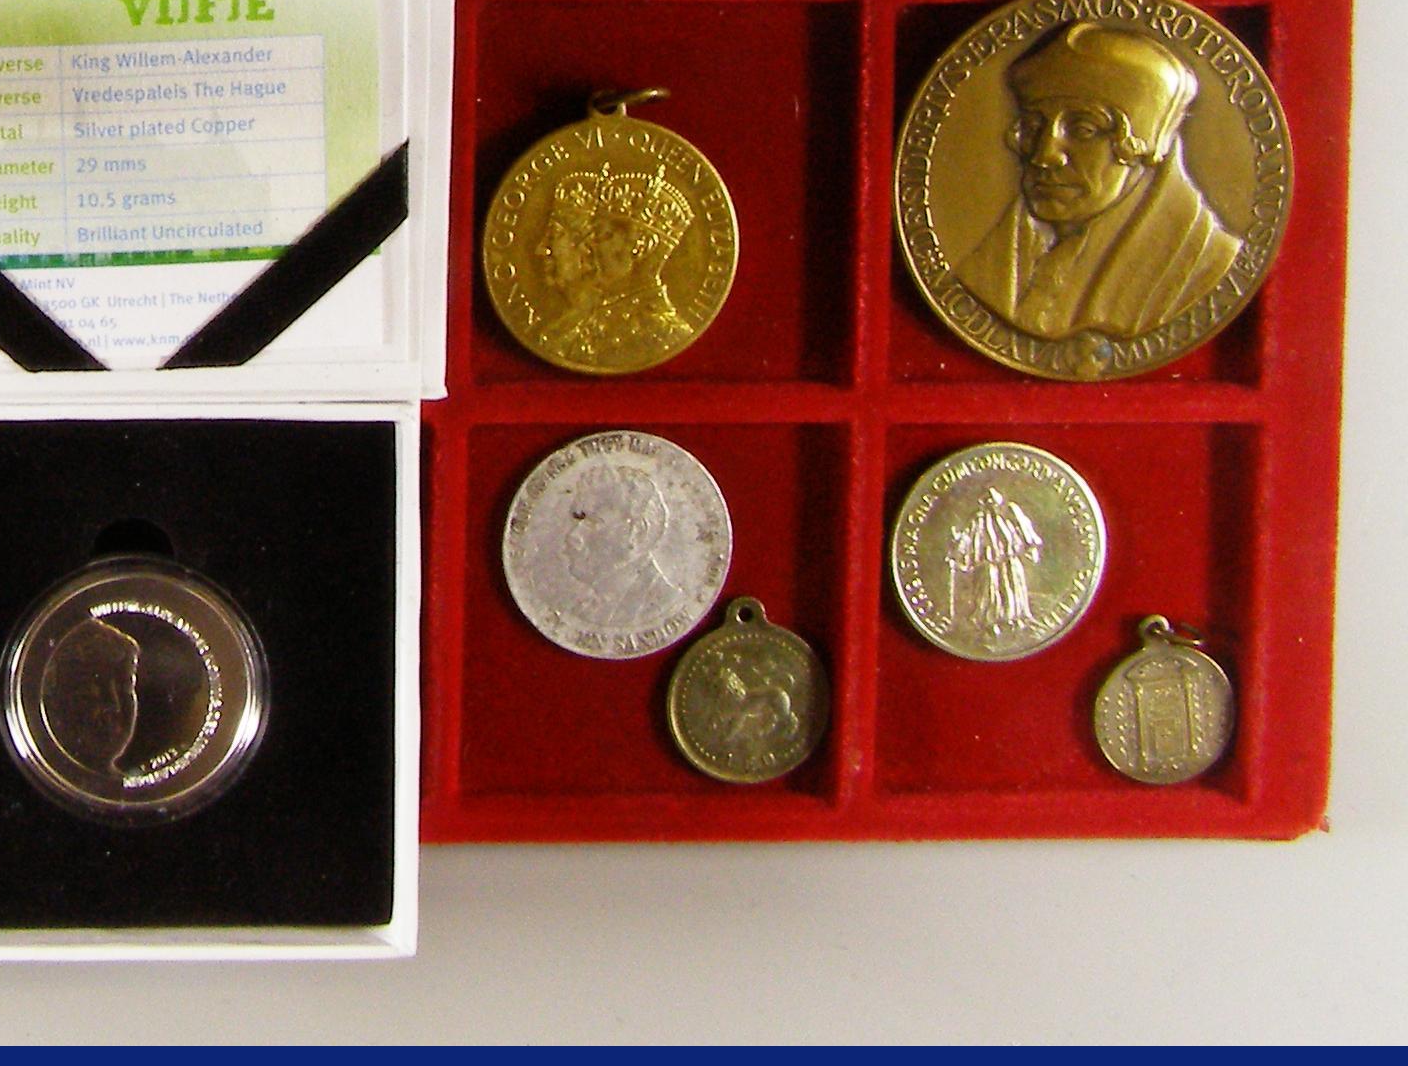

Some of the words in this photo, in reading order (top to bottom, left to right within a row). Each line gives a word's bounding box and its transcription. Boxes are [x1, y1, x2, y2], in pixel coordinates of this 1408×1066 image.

[72, 54, 111, 72] King
[73, 83, 188, 105] Vredespaleis
[192, 82, 225, 99] The
[230, 80, 287, 99] Hague
[74, 122, 124, 140] Silver
[129, 120, 185, 141] plated
[191, 117, 256, 137] Copper
[575, 127, 604, 149] VI
[76, 158, 98, 174] 29
[104, 159, 147, 173] mms
[77, 193, 116, 209] 10.5
[122, 192, 176, 211] grams
[77, 226, 147, 244] Brilliant
[152, 221, 265, 241] Uncirculated
[57, 277, 76, 289] NV
[81, 297, 100, 309] GK
[107, 295, 158, 308] Utrecht
[170, 292, 193, 305] The
[100, 316, 118, 330] 65
